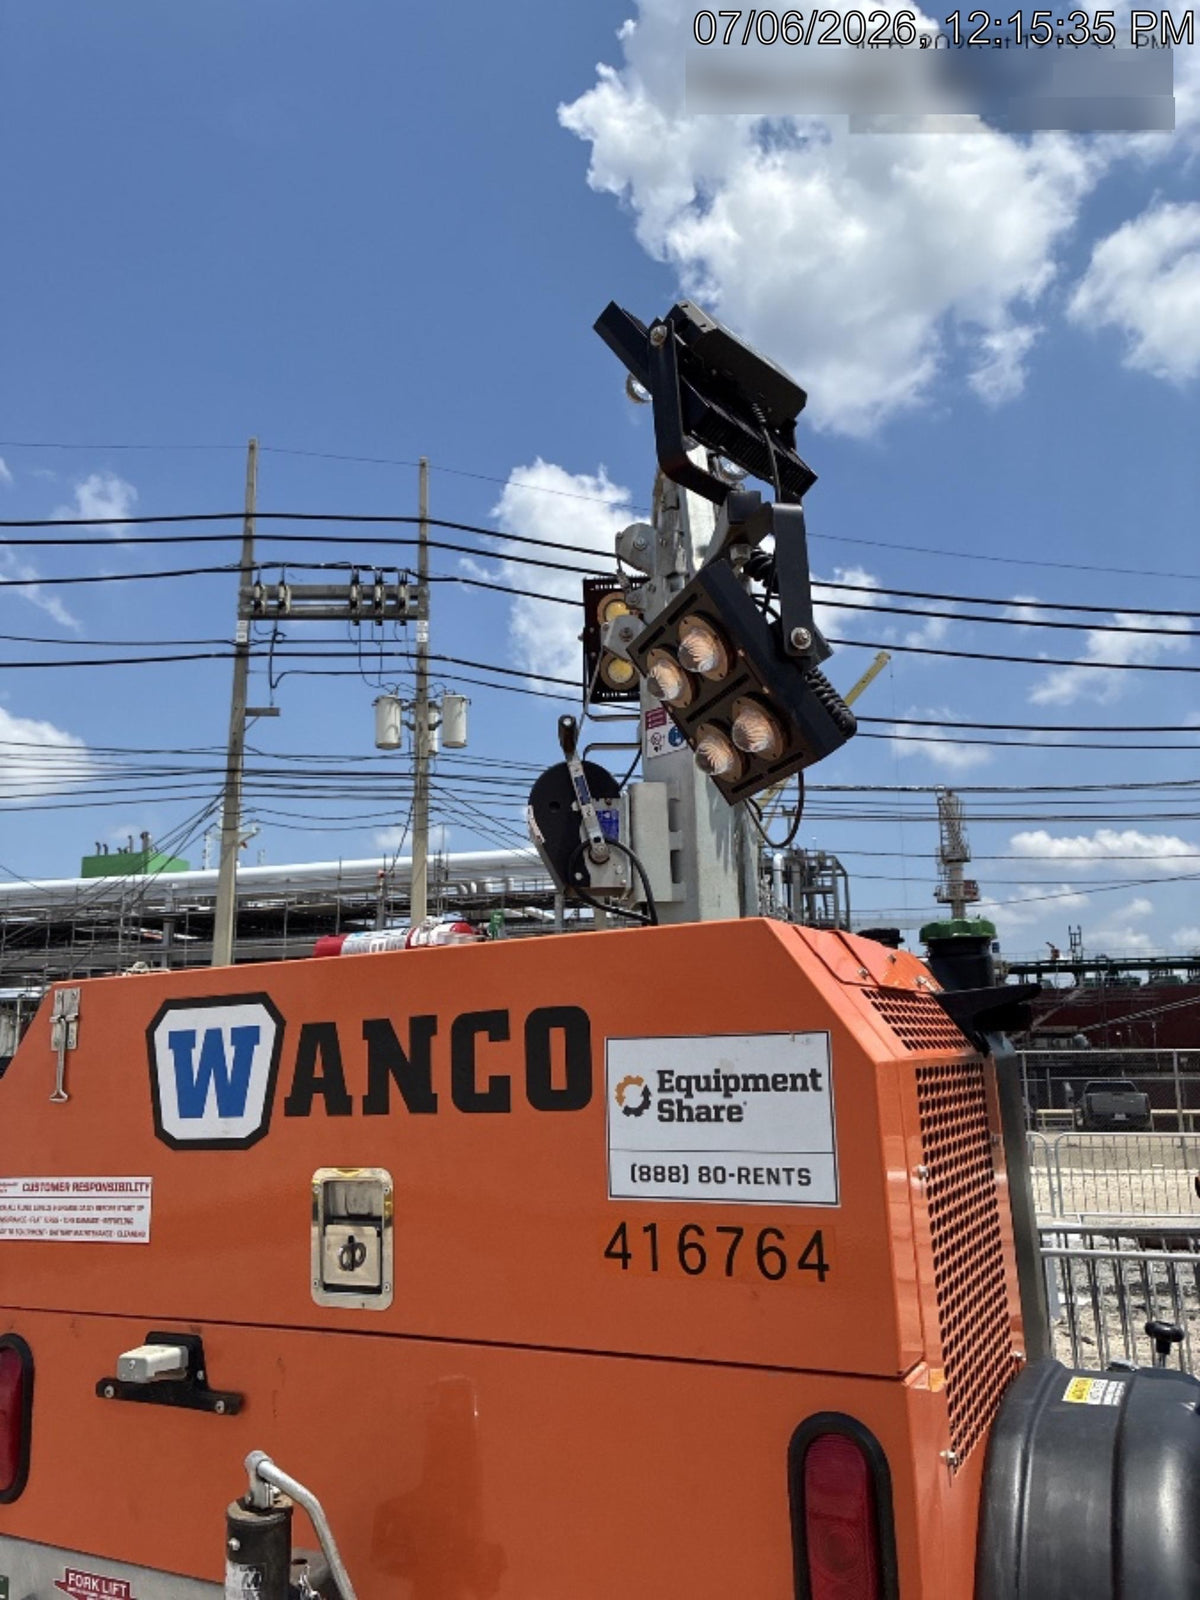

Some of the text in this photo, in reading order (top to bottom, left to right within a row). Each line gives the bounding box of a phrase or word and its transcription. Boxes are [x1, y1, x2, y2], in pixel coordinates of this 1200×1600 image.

[168, 1005, 593, 1118] WANCO
[656, 1068, 823, 1098] Equipment
[656, 1098, 744, 1123] Share
[22, 1181, 70, 1193] CUSTOMER
[72, 1180, 151, 1193] RESPONSIBILITY
[630, 1164, 812, 1187] (888) 80-RENTS
[603, 1220, 831, 1283] 416764
[68, 1572, 100, 1592] FORK
[102, 1579, 127, 1598] LIFT
